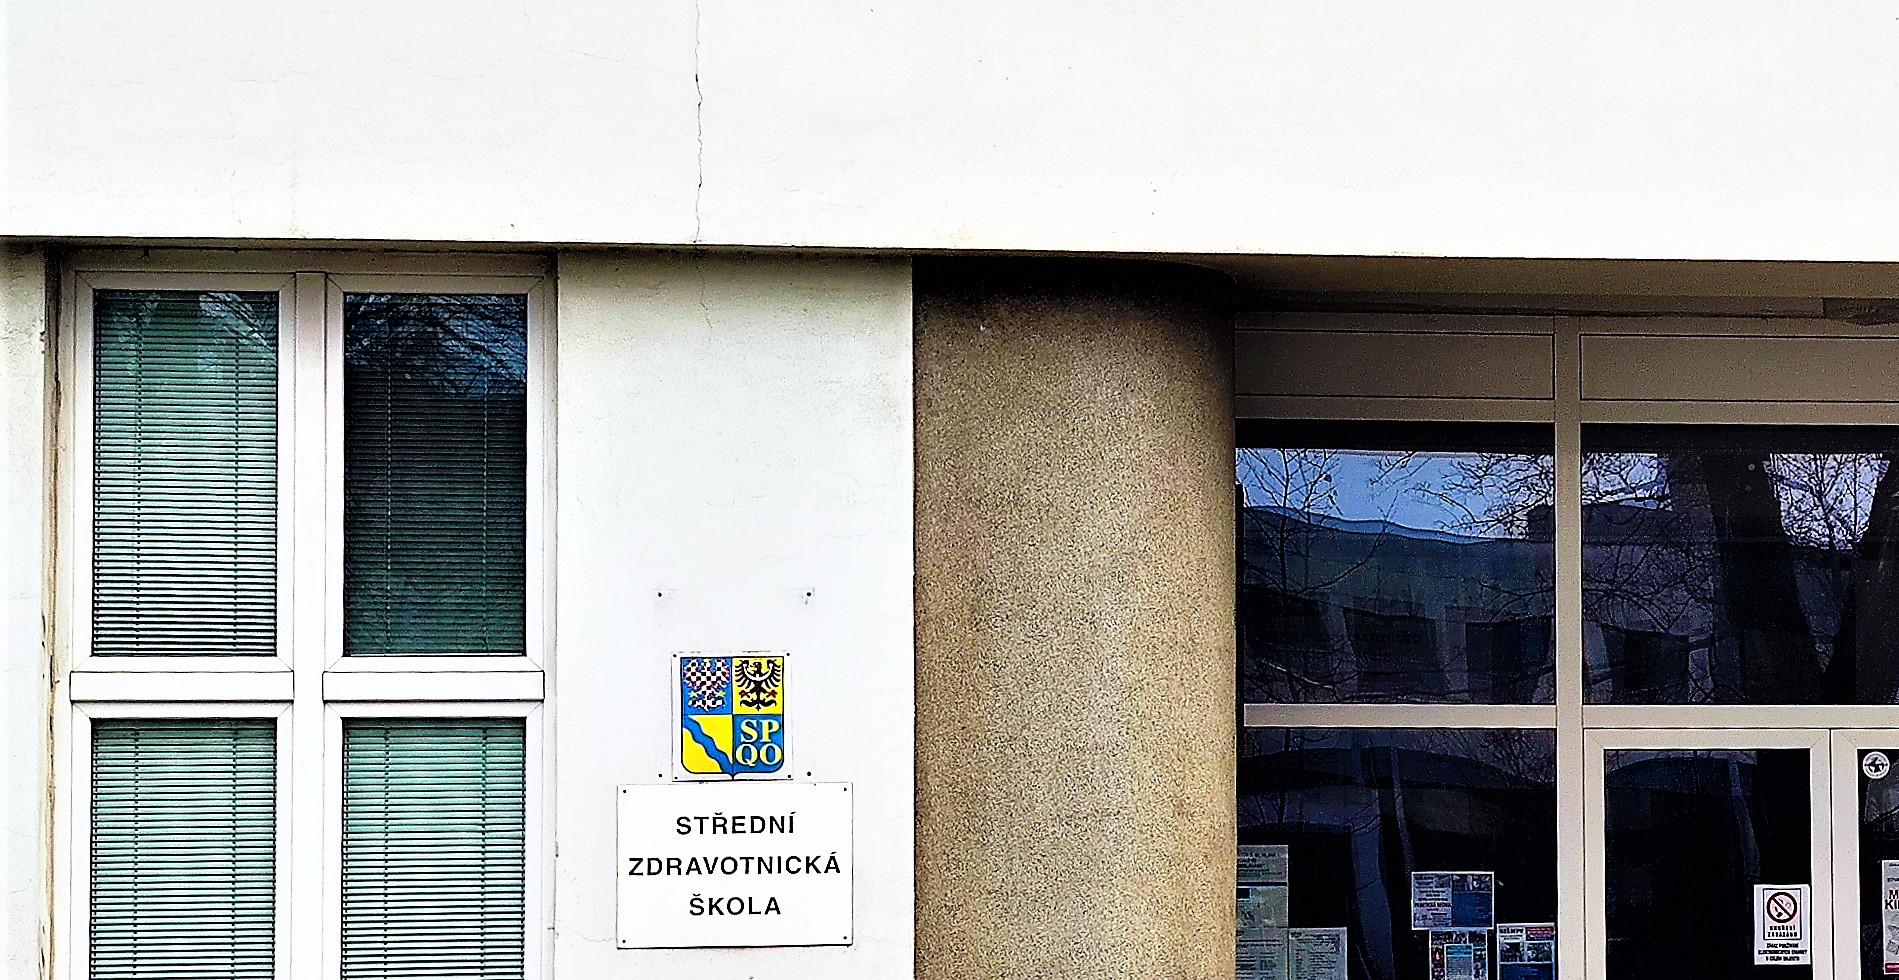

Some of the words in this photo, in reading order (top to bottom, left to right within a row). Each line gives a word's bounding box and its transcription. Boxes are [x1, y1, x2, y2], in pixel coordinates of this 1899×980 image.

[739, 718, 780, 743] SP
[735, 743, 783, 767] QO
[676, 811, 797, 835] STŘEDNÍ
[628, 850, 842, 876] ZDRAVOTNICKÁ
[689, 893, 782, 916] ŠKOLA
